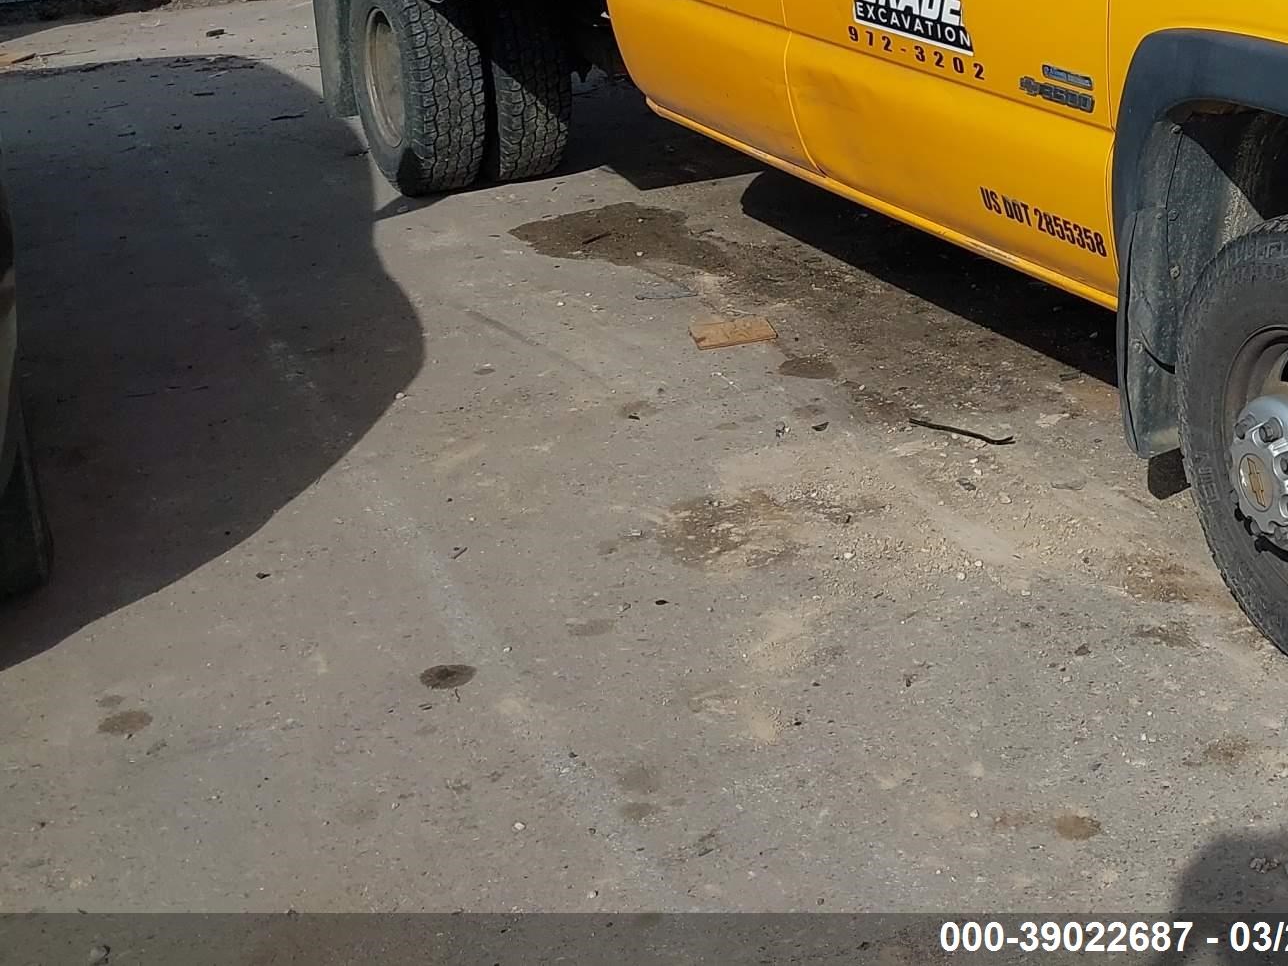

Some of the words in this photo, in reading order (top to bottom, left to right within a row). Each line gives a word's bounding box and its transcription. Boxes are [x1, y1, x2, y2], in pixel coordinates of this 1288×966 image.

[856, 1, 972, 48] EXCAVATION
[847, 26, 986, 80] 972-3202
[980, 186, 1002, 215] US
[1001, 195, 1032, 227] DOT
[1033, 208, 1108, 258] 2855358
